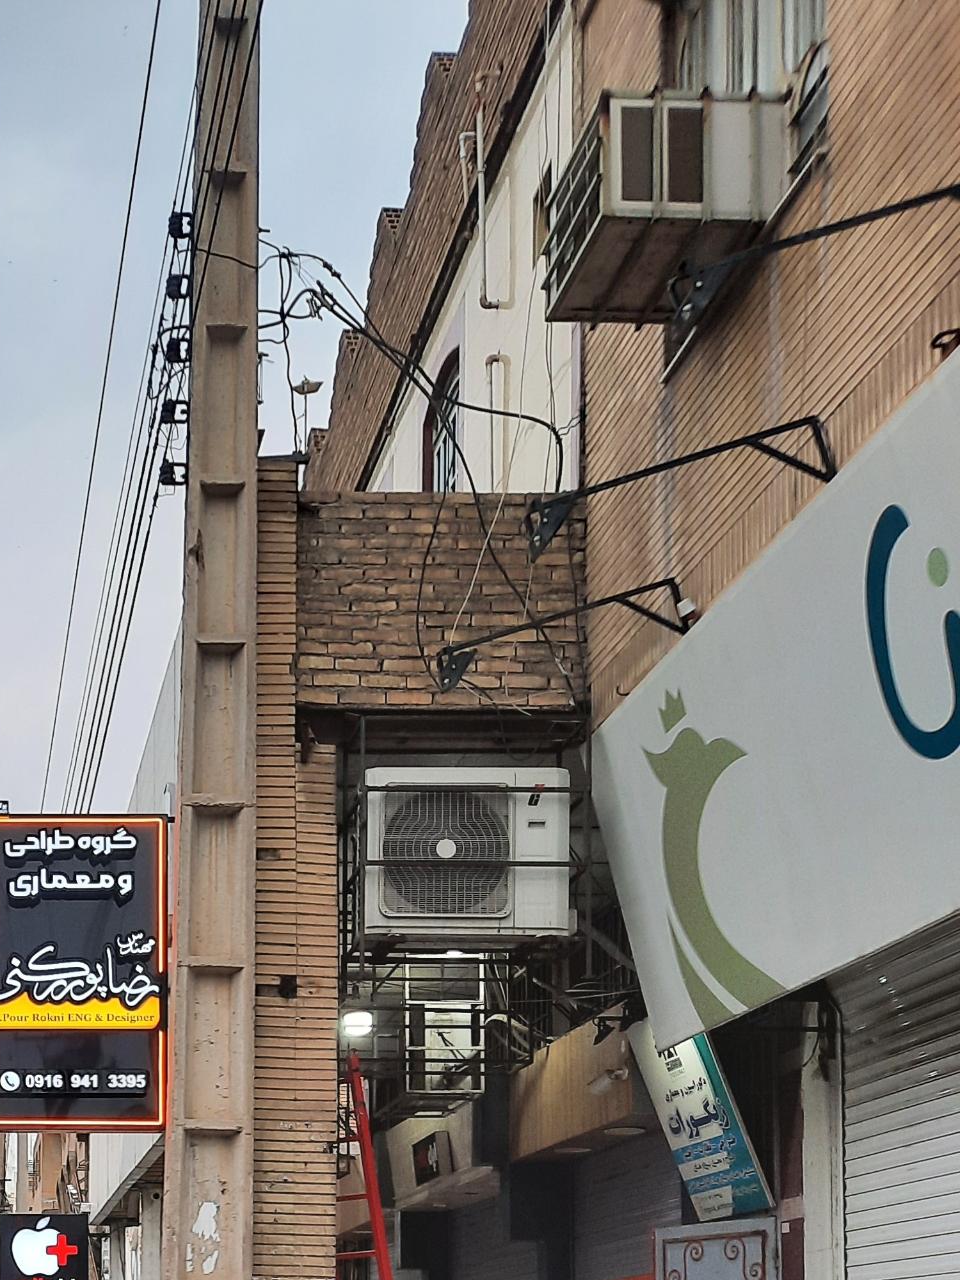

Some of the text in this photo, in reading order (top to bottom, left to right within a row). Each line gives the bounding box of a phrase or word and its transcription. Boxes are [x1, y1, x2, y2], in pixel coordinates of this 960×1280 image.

[4, 827, 137, 857] گروه طراحی
[9, 868, 132, 897] و معماری
[116, 932, 156, 955] مهندس
[107, 947, 160, 1007] رضا
[68, 1013, 92, 1022] ENG
[107, 1012, 154, 1024] Designer
[25, 1073, 146, 1089] 0916 941 3395
